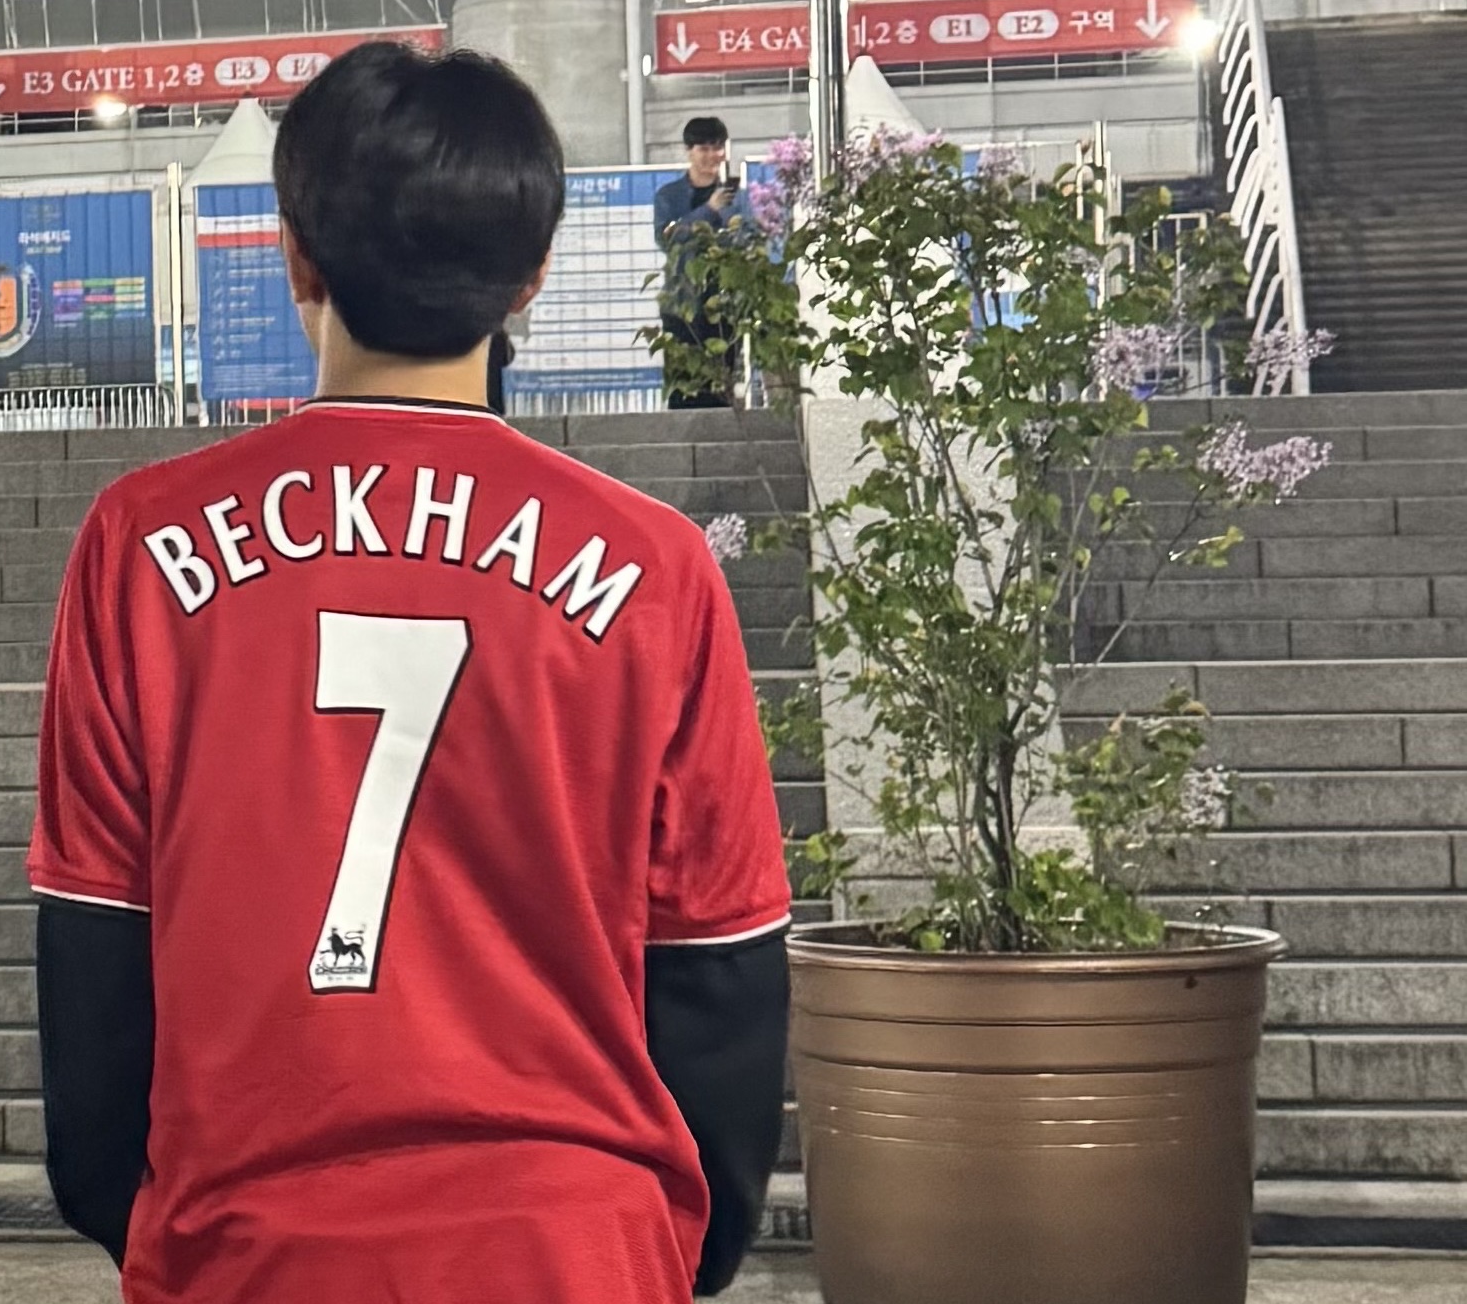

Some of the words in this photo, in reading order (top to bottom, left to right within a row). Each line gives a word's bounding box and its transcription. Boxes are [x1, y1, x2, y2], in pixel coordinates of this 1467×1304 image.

[22, 70, 54, 95] E3
[61, 67, 135, 93] GATE
[231, 61, 256, 79] E3
[718, 28, 754, 53] E4
[760, 26, 810, 52] GA
[945, 19, 974, 39] E1
[1013, 16, 1046, 35] E2
[1067, 8, 1115, 35] 구역
[143, 464, 642, 643] BECKHAM
[309, 609, 472, 994] 7
